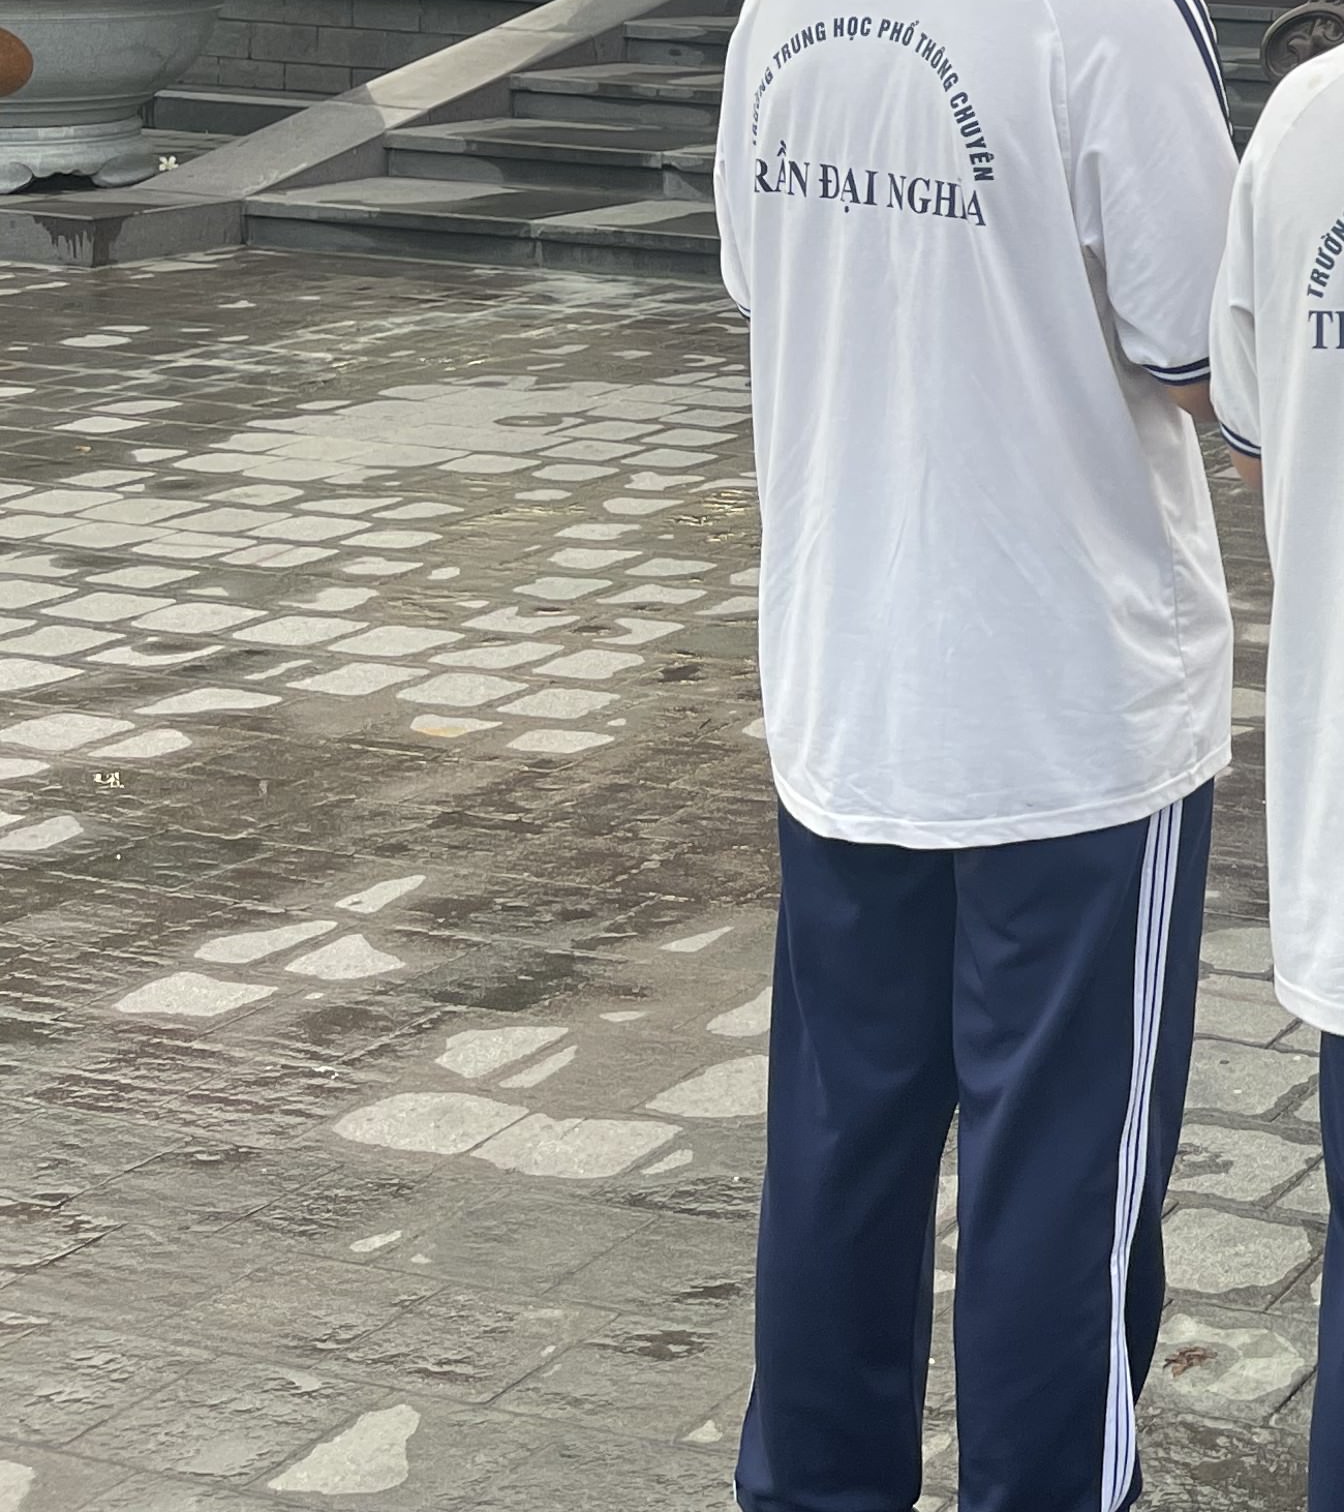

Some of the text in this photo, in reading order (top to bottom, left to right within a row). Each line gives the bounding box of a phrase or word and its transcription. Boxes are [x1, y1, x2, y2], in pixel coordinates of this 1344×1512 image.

[773, 21, 826, 71] TRUNG
[832, 16, 872, 41] HỌC
[877, 18, 920, 47] PHỔ
[914, 33, 959, 93] THÔNG
[949, 90, 995, 182] CHUYÊN
[754, 139, 810, 198] RẦN
[818, 163, 878, 213] ĐẠI
